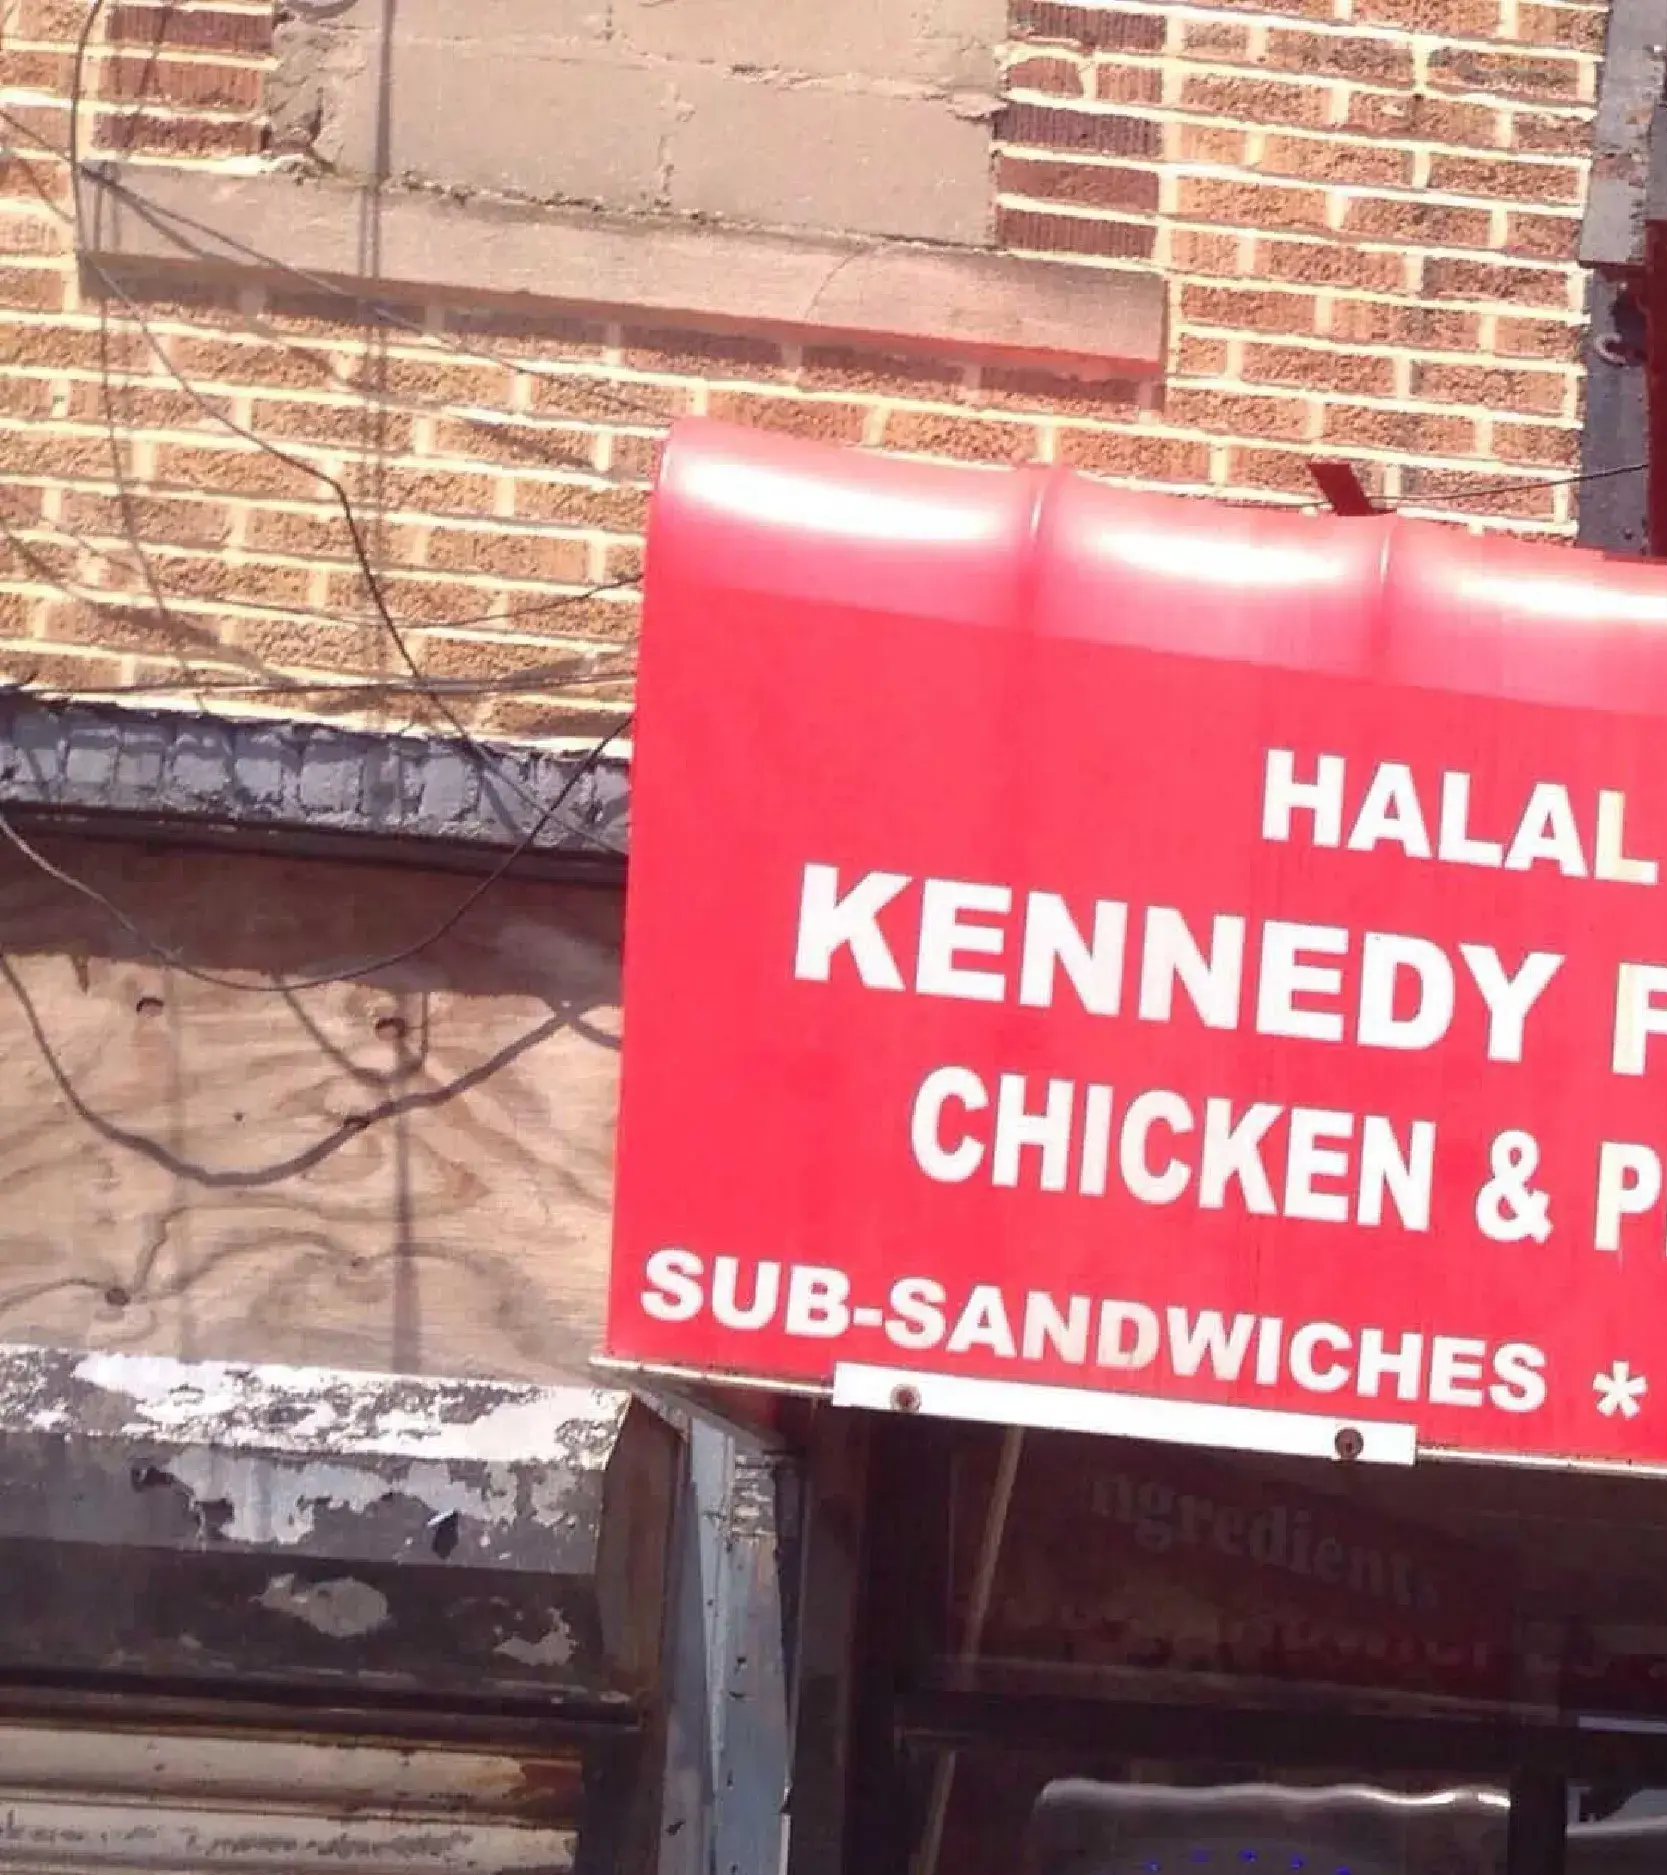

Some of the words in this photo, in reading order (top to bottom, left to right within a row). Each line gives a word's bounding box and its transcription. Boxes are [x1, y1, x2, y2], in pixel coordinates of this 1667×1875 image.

[1263, 749, 1658, 885] HALAL
[796, 865, 1560, 1063] KENNEDY
[912, 1066, 1435, 1231] CHICKEN
[1476, 1130, 1553, 1242] &
[640, 1250, 1546, 1412] SUB-SANDWICHES
